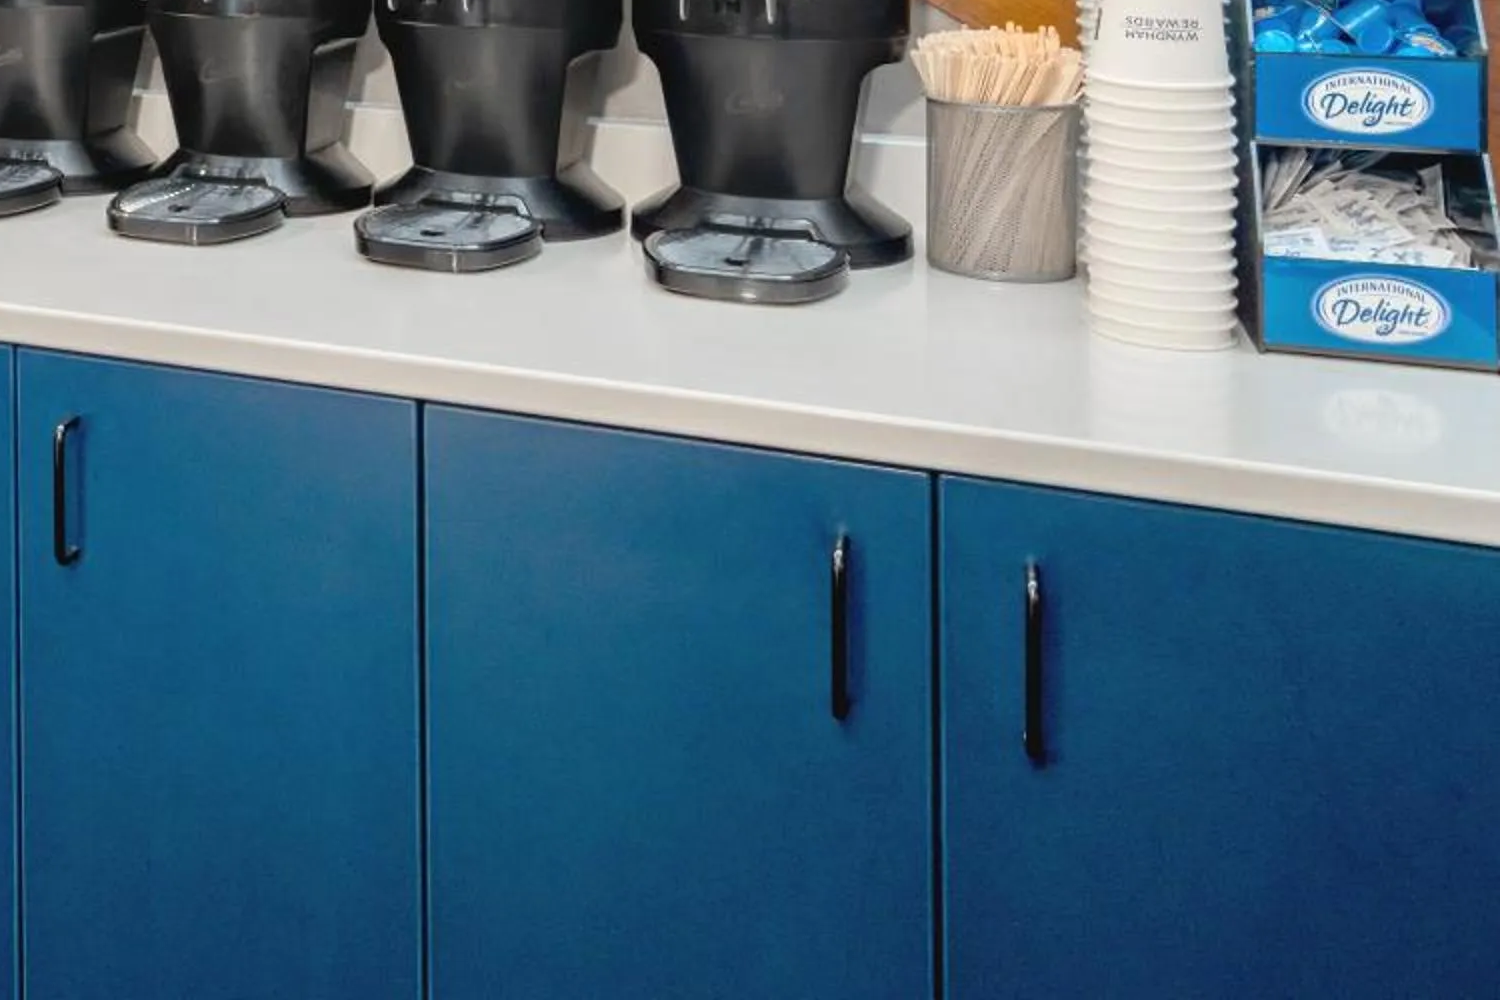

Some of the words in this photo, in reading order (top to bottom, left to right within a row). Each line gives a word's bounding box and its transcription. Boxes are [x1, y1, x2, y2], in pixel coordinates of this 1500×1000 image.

[1124, 31, 1200, 41] WYNDHAM
[1325, 76, 1412, 93] INTERNATIONAL
[1320, 91, 1417, 127] Delight
[1337, 282, 1426, 302] INTERNATIONAL
[1331, 298, 1432, 336] Delight
